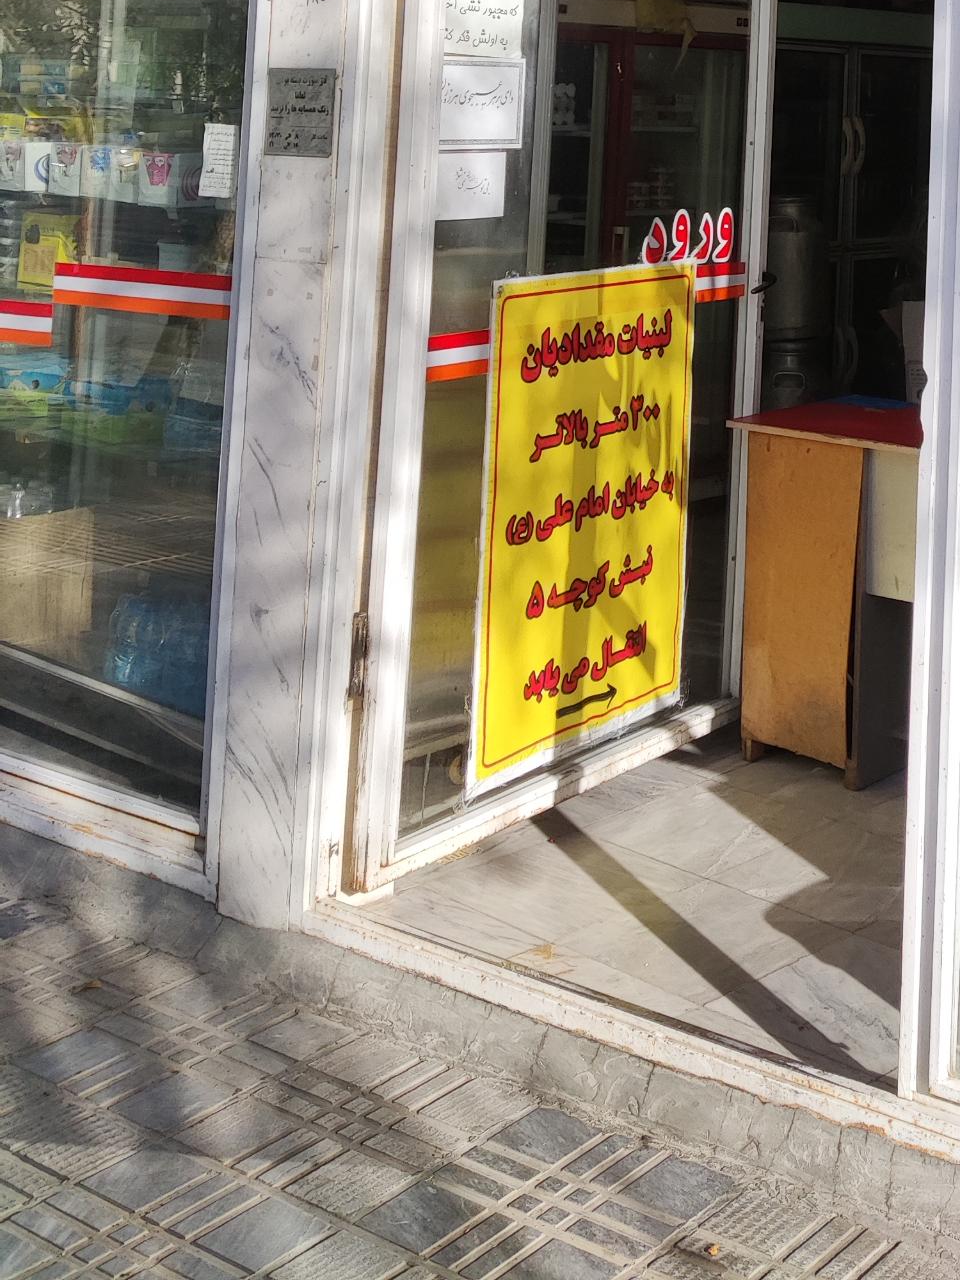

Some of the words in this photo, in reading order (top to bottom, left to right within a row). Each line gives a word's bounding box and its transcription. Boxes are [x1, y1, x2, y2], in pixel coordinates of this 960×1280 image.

[482, 7, 508, 19] مجبور
[510, 5, 520, 16] که
[456, 30, 471, 43] فکر
[472, 29, 498, 48] اولش
[500, 37, 509, 51] به
[642, 207, 734, 265] ورود
[520, 321, 616, 384] مقدادیان
[617, 308, 673, 360] لبنیات
[589, 406, 629, 448] متر
[630, 393, 661, 431] ۳۰۰
[529, 408, 589, 463] بالاتر
[576, 481, 610, 532] امام
[612, 469, 660, 519] خیابان
[661, 470, 674, 501] به
[506, 511, 534, 545] (ع)
[536, 493, 573, 541] علی
[547, 560, 610, 612] کوچه
[608, 544, 653, 598] نبش
[525, 580, 545, 619] ۵
[590, 620, 647, 682] انتقال
[524, 658, 560, 703] یابد
[561, 657, 590, 694] می
